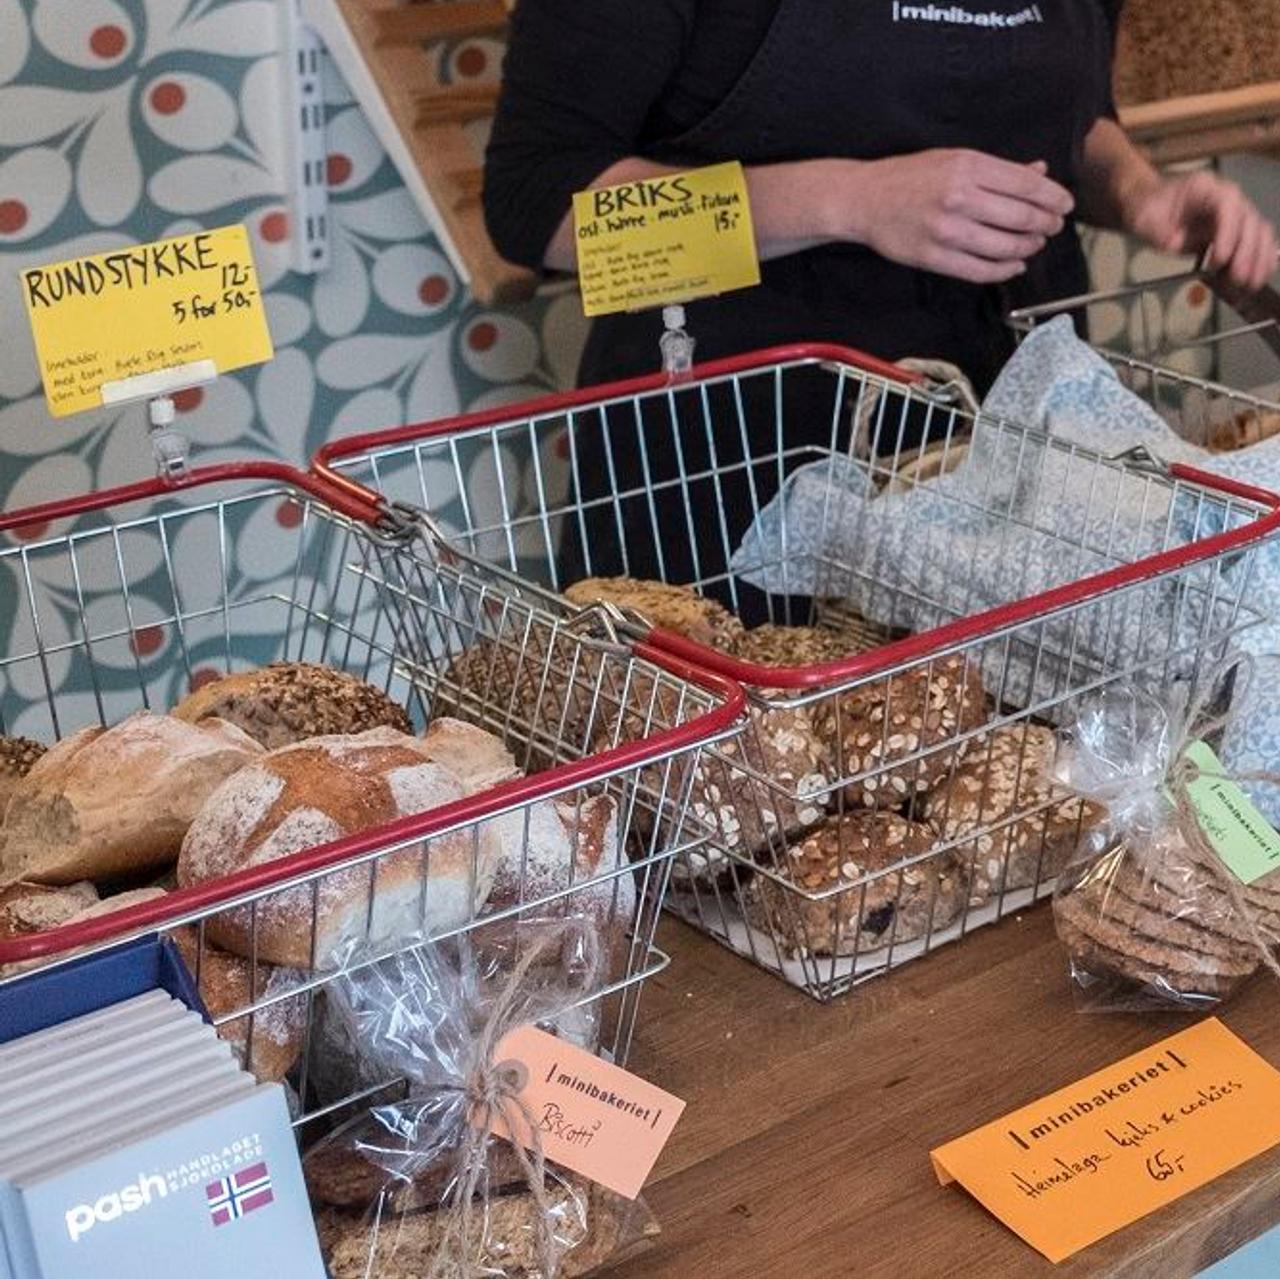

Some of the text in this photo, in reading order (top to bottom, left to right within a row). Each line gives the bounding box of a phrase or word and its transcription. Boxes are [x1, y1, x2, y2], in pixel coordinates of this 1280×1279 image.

[594, 177, 692, 217] BRIKS
[26, 235, 218, 307] RUNDSTYKKE
[192, 294, 217, 319] for
[1180, 1079, 1242, 1116] cookies
[166, 1133, 261, 1181] HANDLAGET
[65, 1172, 168, 1243] pash
